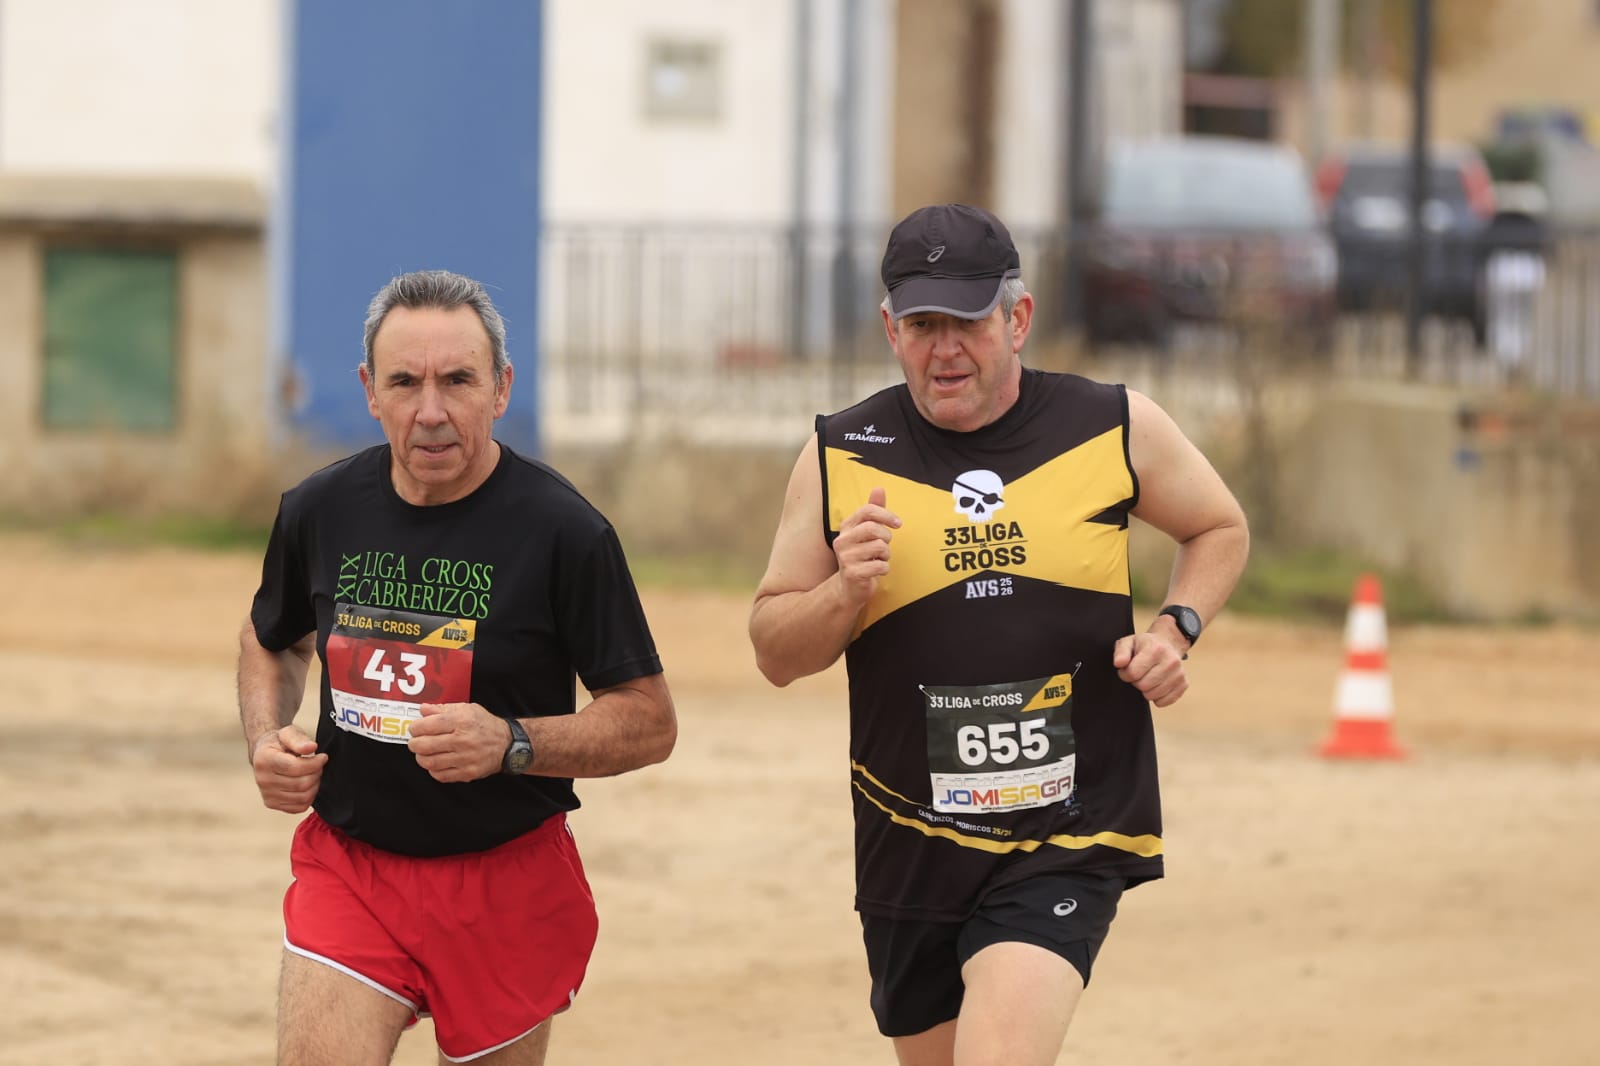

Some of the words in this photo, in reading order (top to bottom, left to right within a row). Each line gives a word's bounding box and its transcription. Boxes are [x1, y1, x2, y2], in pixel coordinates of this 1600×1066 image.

[843, 433, 896, 444] TEAMERGY
[362, 551, 407, 580] LIGA
[421, 557, 494, 591] CROSS
[944, 545, 1027, 572] CROSS
[335, 552, 362, 601] XIX
[965, 579, 1000, 599] AVS
[1000, 577, 1013, 587] 25
[355, 578, 490, 619] CABRERIZOS
[1001, 587, 1014, 596] 26
[348, 615, 373, 630] LIGA
[382, 620, 421, 636] CROSS
[363, 648, 427, 696] 43
[930, 696, 944, 708] 33
[945, 696, 972, 709] LIGA
[982, 692, 1023, 707] CROSS
[957, 717, 1050, 766] 655
[940, 775, 1072, 807] JOMISAGA
[956, 820, 992, 833] MORISCOS
